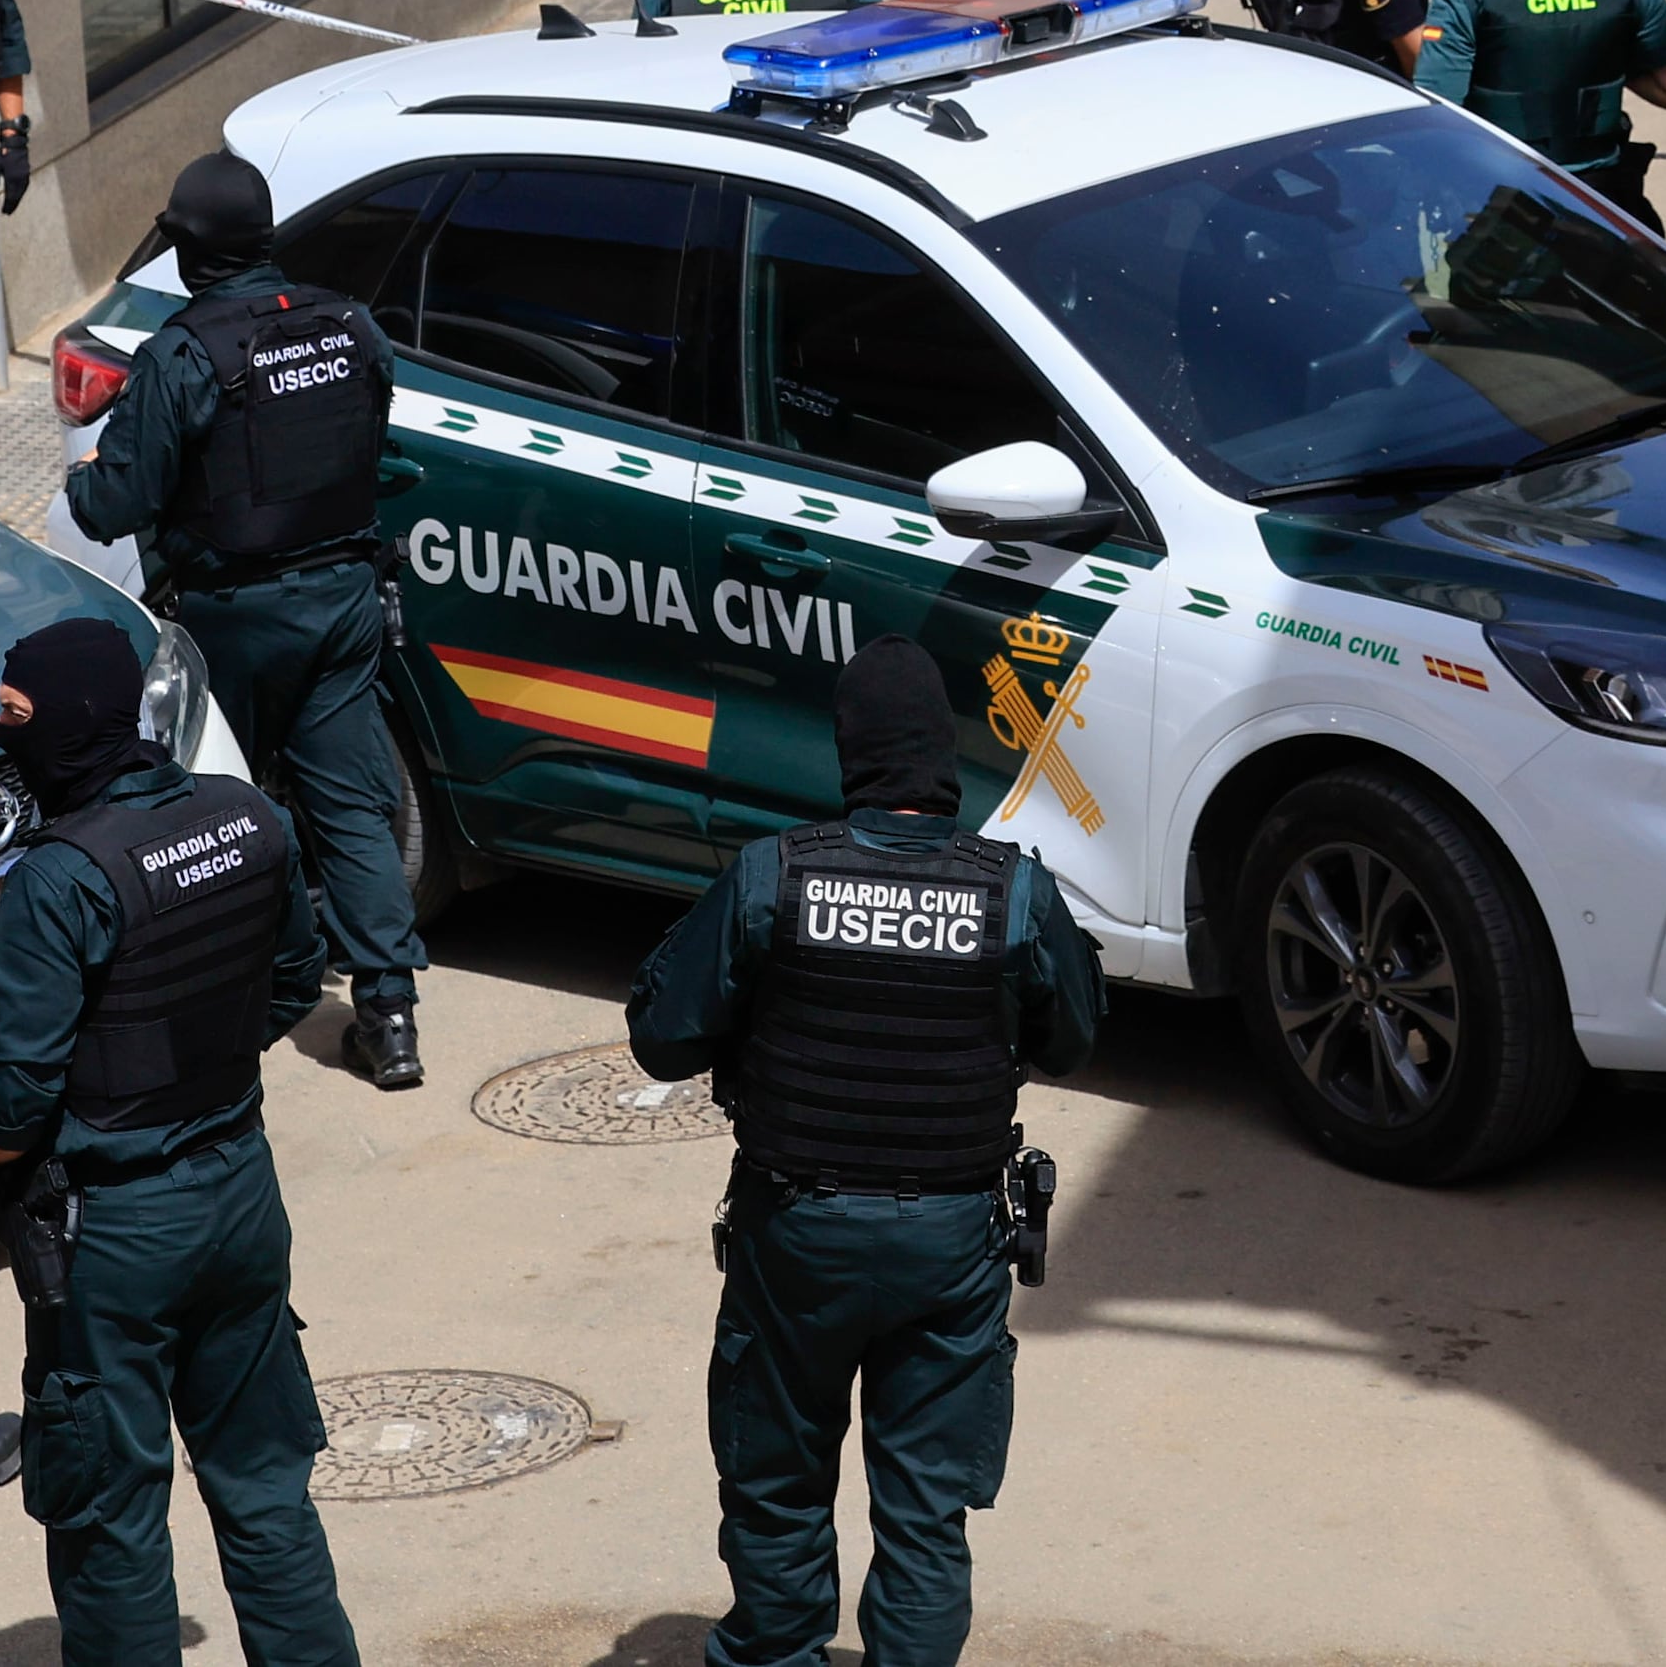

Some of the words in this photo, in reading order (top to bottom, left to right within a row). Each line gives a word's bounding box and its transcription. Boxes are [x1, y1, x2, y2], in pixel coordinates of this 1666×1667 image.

[253, 342, 316, 367] GUARDIA
[320, 333, 354, 351] CIVIL
[269, 357, 350, 394] USECIC
[409, 518, 699, 634] GUARDIA
[1256, 612, 1342, 650] GUARDIA
[1348, 637, 1400, 665] CIVIL
[142, 832, 218, 872] GUARDIA
[218, 817, 258, 843] CIVIL
[175, 849, 243, 888] USECIC
[806, 879, 913, 910] GUARDIA
[920, 889, 982, 916] CIVIL
[807, 905, 979, 954] USECIC
